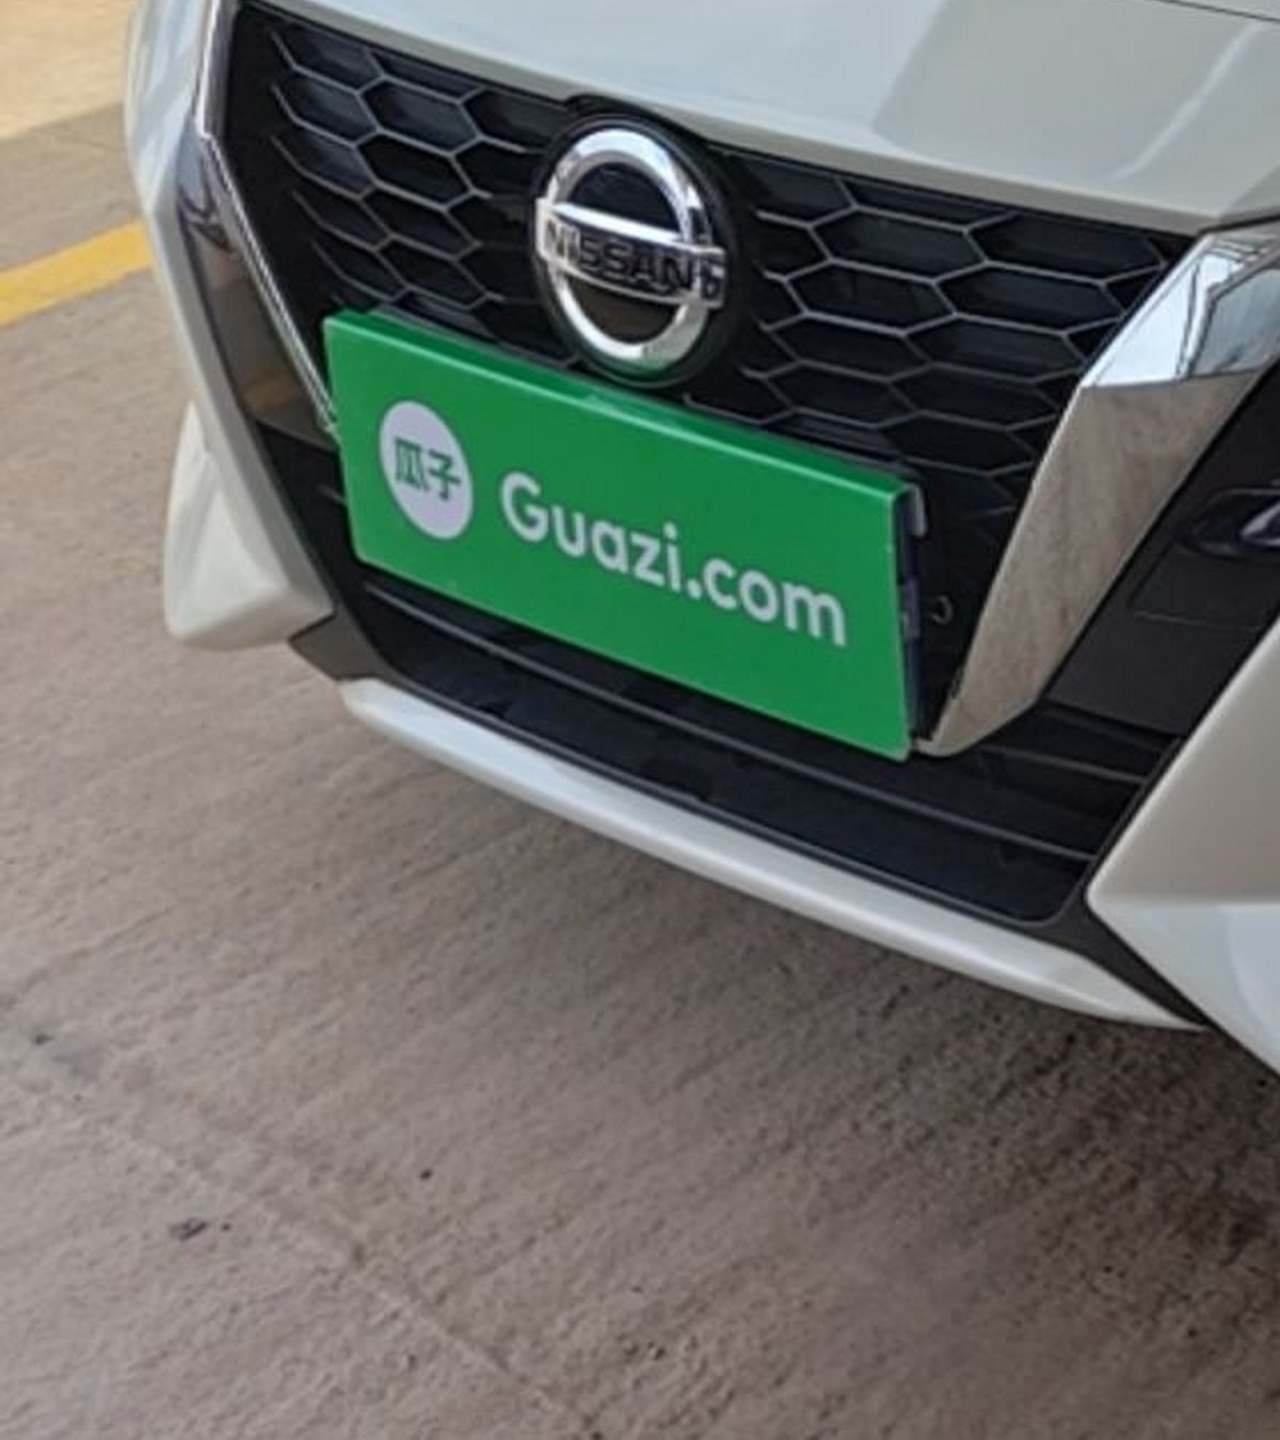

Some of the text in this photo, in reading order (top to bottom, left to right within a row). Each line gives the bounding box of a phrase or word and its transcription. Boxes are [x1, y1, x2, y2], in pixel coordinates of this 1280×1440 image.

[544, 216, 699, 300] NISSAN
[395, 436, 463, 501] 瓜子
[500, 471, 848, 648] Guazi.com
